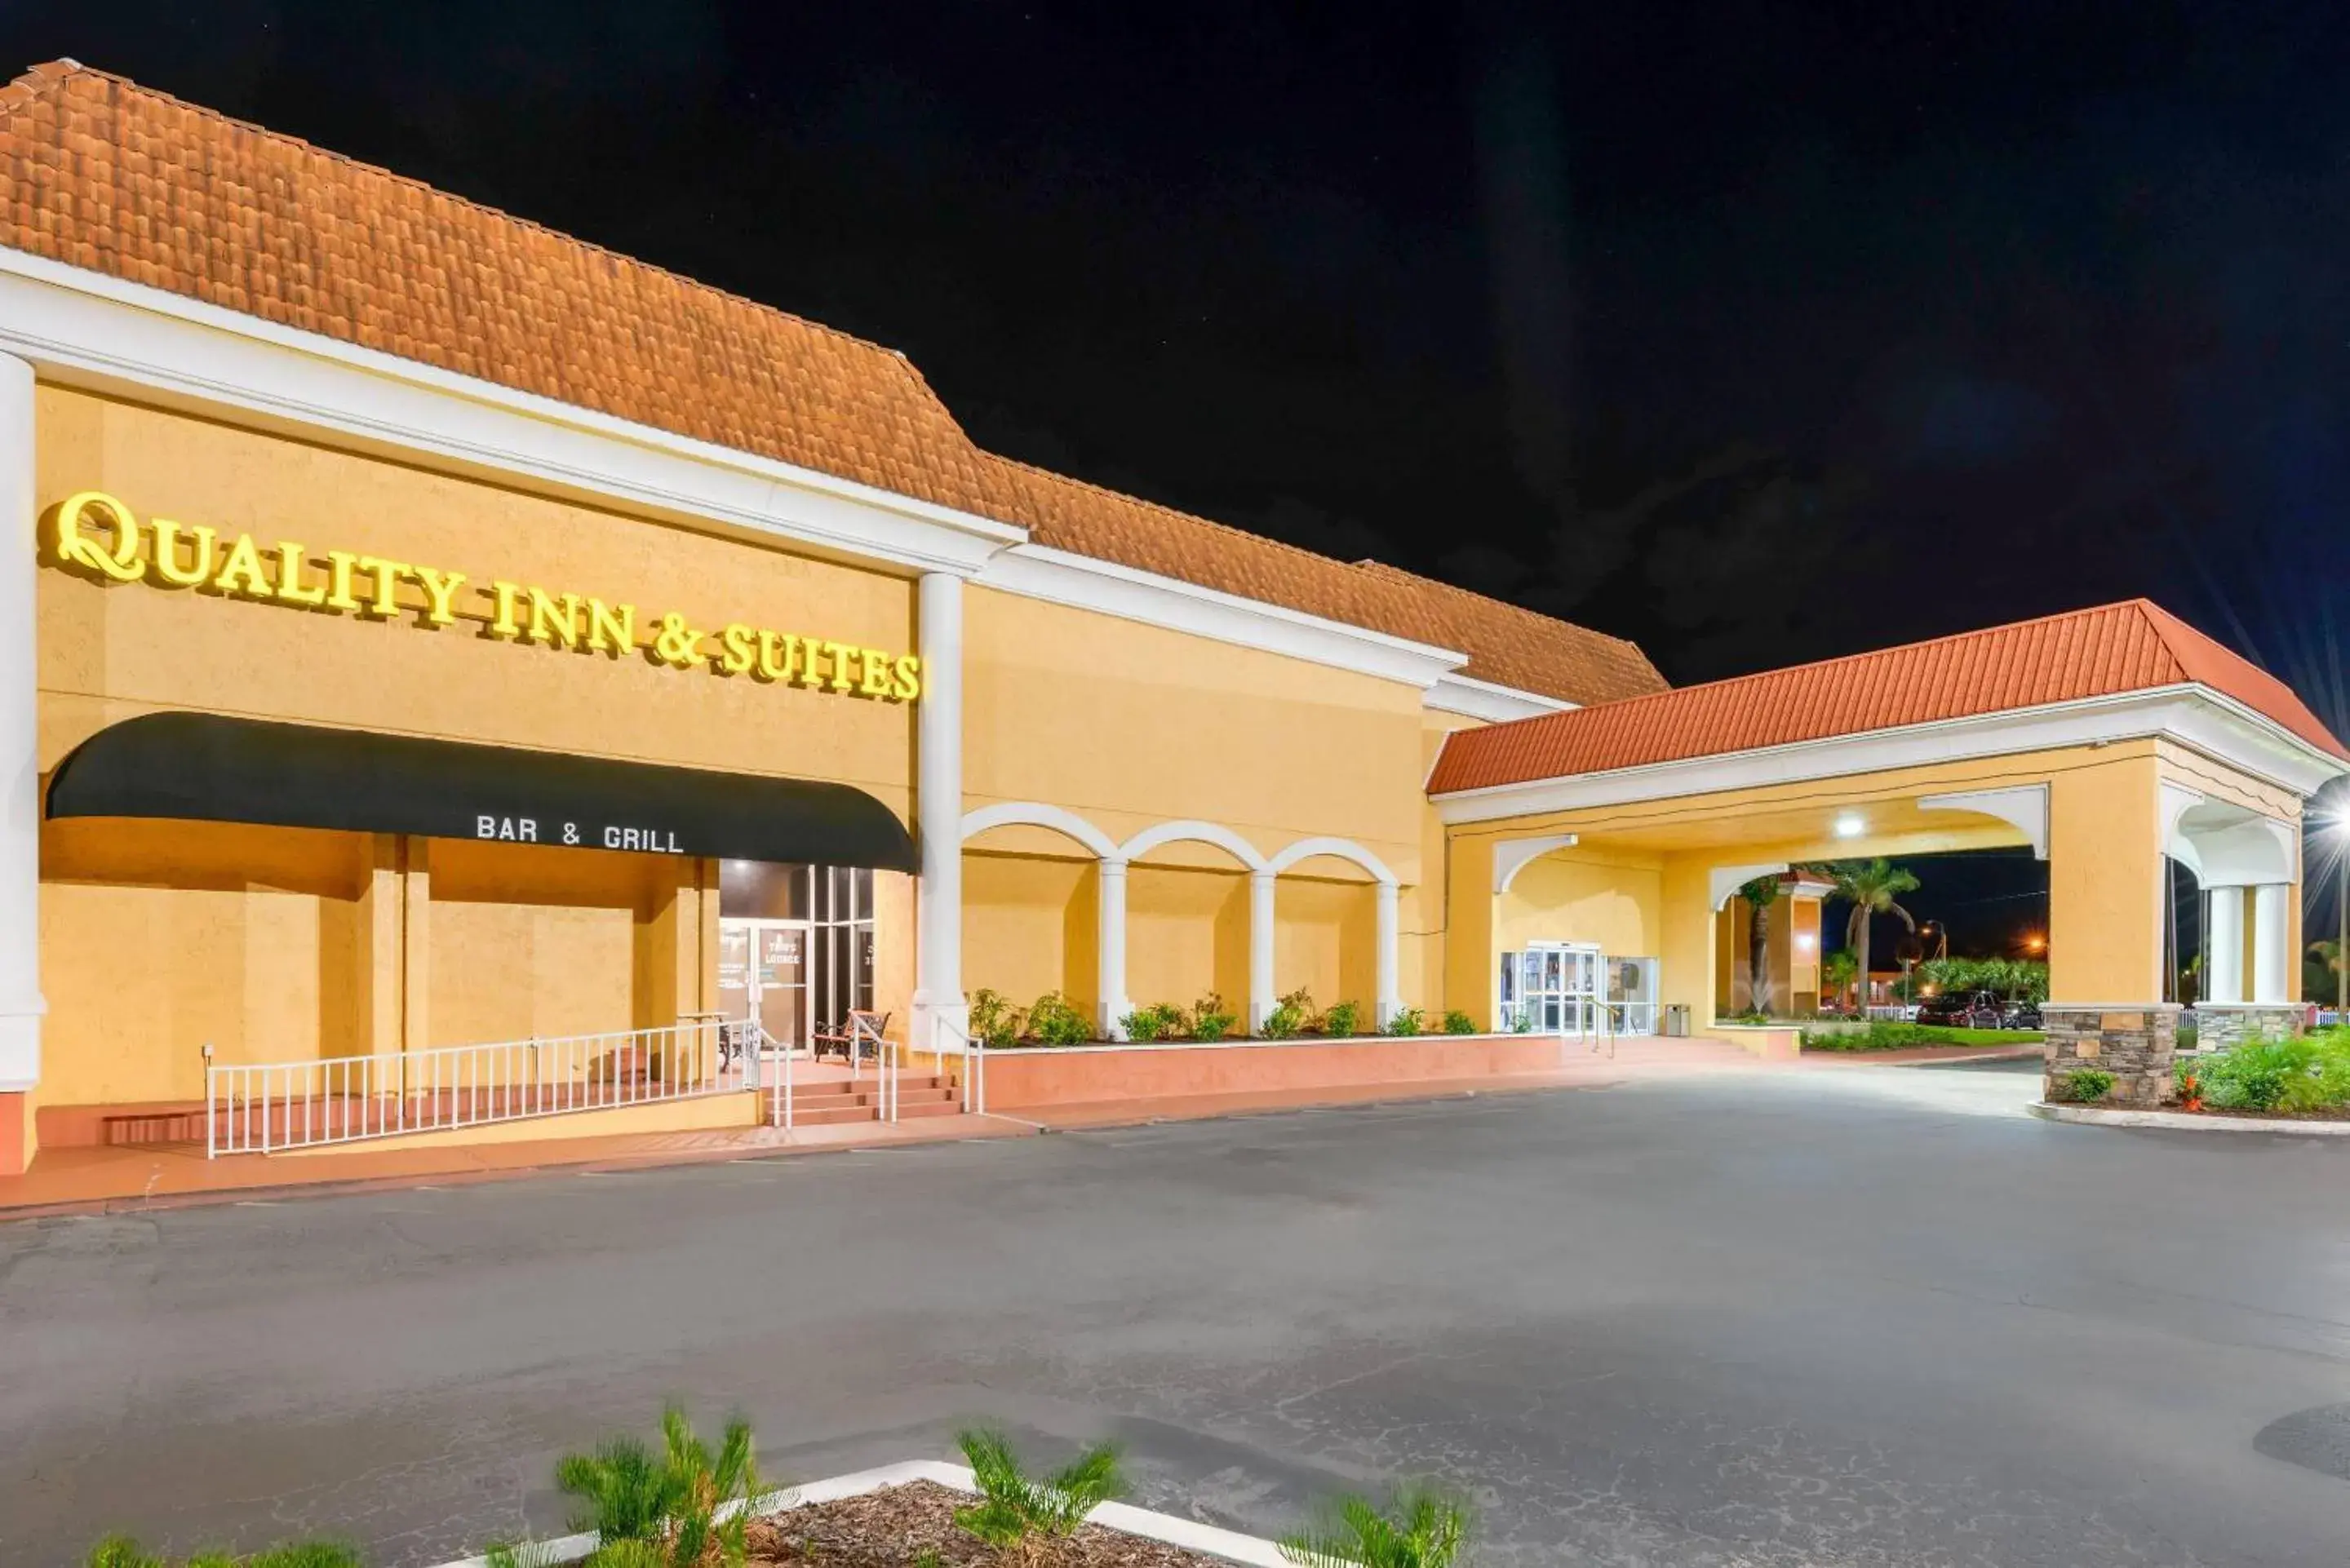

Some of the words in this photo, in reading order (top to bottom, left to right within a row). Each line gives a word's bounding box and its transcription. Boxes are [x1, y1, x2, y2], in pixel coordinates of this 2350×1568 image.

[58, 491, 466, 625] QUALITY
[492, 580, 636, 654] INN
[657, 613, 708, 665] &
[721, 622, 920, 701] SUITES
[477, 815, 537, 843] BAR
[563, 822, 580, 845] &
[604, 826, 684, 853] GRILL
